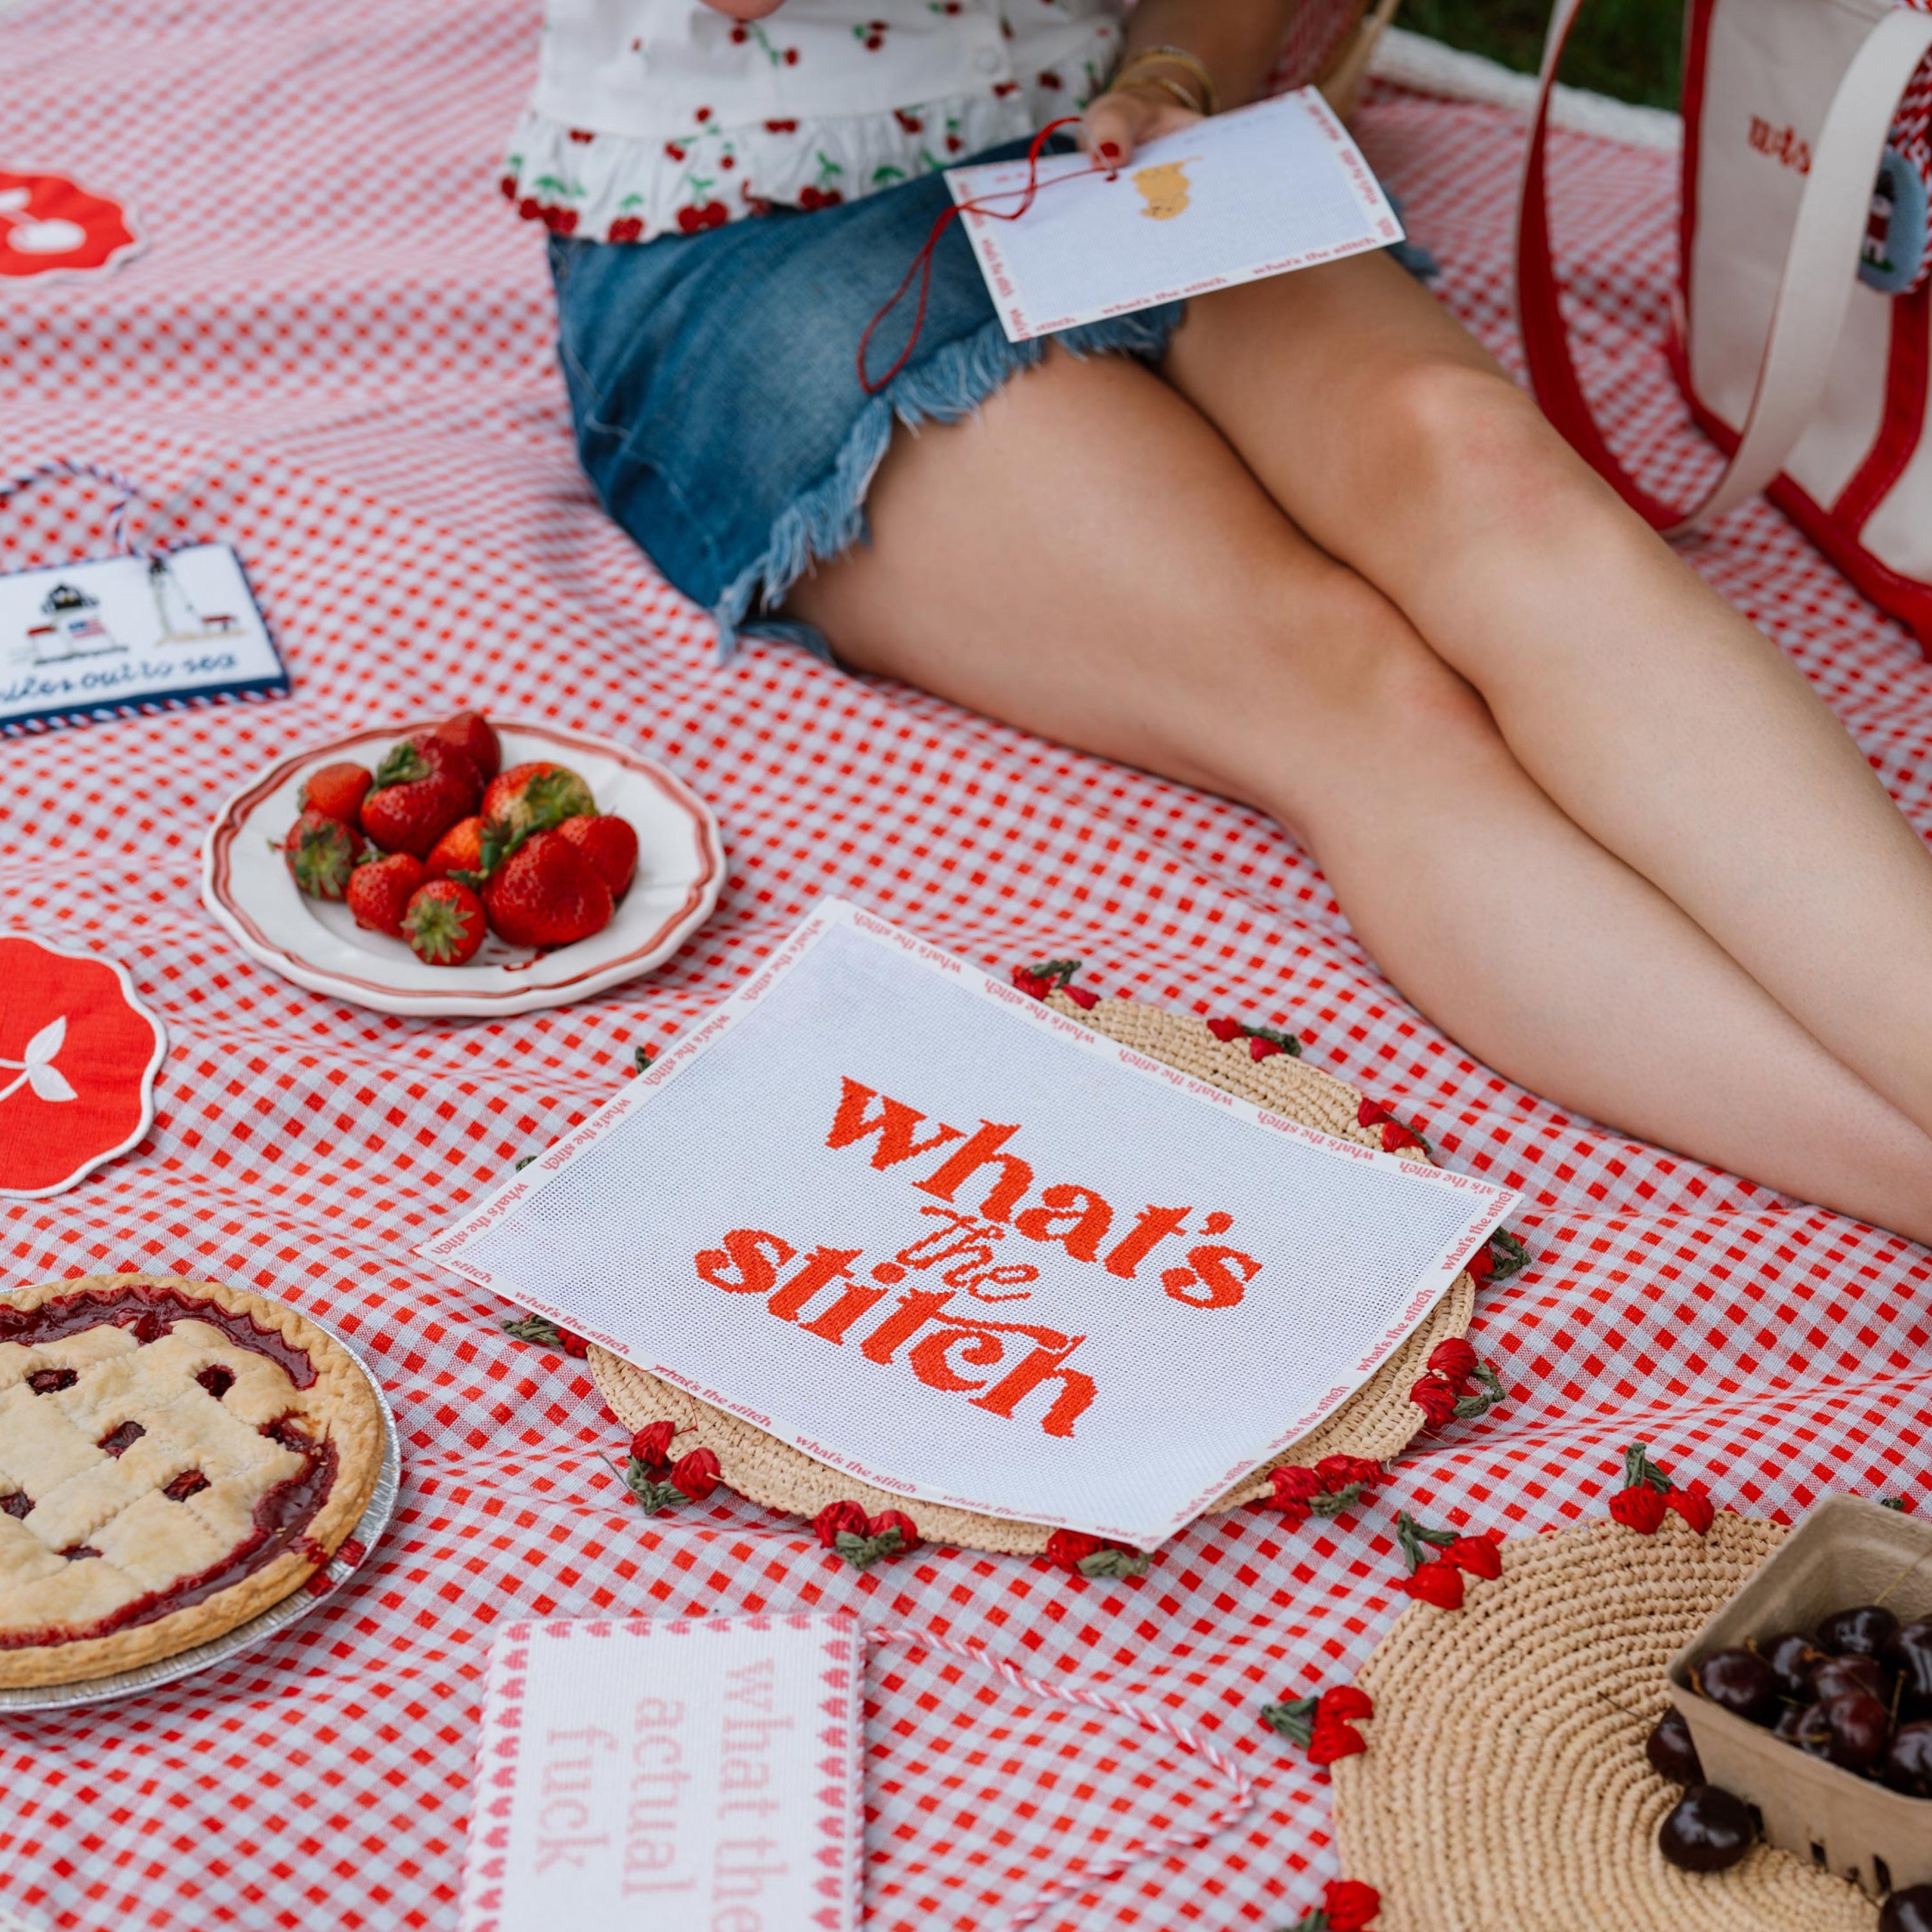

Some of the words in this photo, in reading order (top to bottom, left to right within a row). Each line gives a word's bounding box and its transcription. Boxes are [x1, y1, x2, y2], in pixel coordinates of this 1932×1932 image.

[81, 663, 133, 689] out
[140, 660, 175, 678] to
[183, 652, 238, 673] sea
[854, 911, 893, 938] stitch
[893, 933, 916, 951] the
[919, 945, 961, 973] what's
[985, 978, 1025, 1009] stitch
[1026, 1002, 1049, 1021] the
[693, 1014, 730, 1043] what's
[1052, 1017, 1095, 1044] what's
[674, 1042, 697, 1059] the
[1119, 1049, 1160, 1072] stitch
[643, 1058, 676, 1085] stitch
[1162, 1069, 1185, 1086] the
[1187, 1081, 1233, 1106] what's
[592, 1099, 632, 1128] what's
[1258, 1111, 1298, 1133] stitch
[573, 1128, 597, 1144] the
[1302, 1130, 1325, 1146] the
[1328, 1139, 1374, 1160] what's
[540, 1143, 575, 1170] stitch
[1399, 1161, 1442, 1180] stitch
[1444, 1172, 1468, 1188] the
[487, 1182, 529, 1215] what's
[825, 1076, 1263, 1309] what's
[1470, 1182, 1495, 1194] at's
[466, 1215, 491, 1232] the
[431, 1231, 469, 1256] stitch
[897, 1207, 1039, 1303] the
[1441, 1235, 1476, 1271] what's
[1469, 1217, 1492, 1235] the
[451, 1260, 493, 1283] stitch
[515, 1291, 561, 1318] what's
[562, 1316, 587, 1331] the
[587, 1331, 630, 1354] stitch
[694, 1229, 1097, 1438] stitch
[1356, 1339, 1392, 1372] what's
[1386, 1322, 1409, 1340] the
[1405, 1287, 1436, 1322] stitch
[654, 1363, 701, 1392] what's
[702, 1388, 728, 1405] the
[728, 1402, 772, 1427] stitch
[1266, 1426, 1304, 1449] what's
[1298, 1411, 1321, 1426] the
[1318, 1385, 1350, 1411] stitch
[795, 1435, 844, 1466] what's
[845, 1461, 873, 1477] the
[873, 1475, 918, 1494] stitch
[722, 1656, 796, 1819] what
[534, 1726, 620, 1877] fuck
[621, 1695, 698, 1899] actual
[710, 1837, 791, 1932] the
